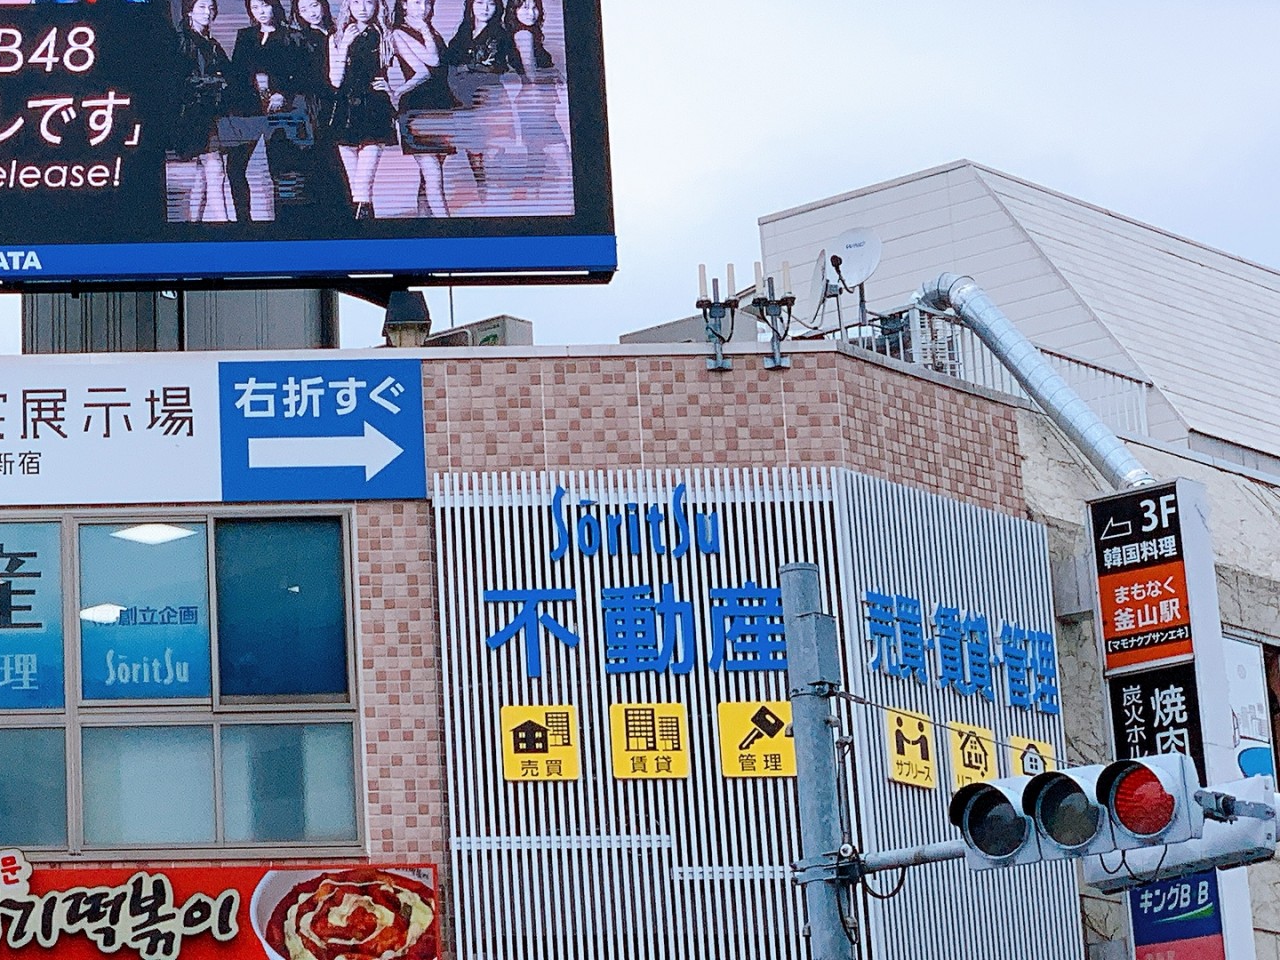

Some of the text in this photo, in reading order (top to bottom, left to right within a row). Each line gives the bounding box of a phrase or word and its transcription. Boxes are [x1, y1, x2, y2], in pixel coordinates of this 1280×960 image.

[234, 376, 404, 419] 右折すぐ
[1139, 494, 1177, 533] 3F
[1103, 535, 1178, 569] 韓国料理
[1114, 576, 1176, 604] まもなく
[483, 581, 787, 678] 不動産
[1114, 597, 1182, 632] 釜山駅
[1150, 684, 1190, 756] 焼肉
[521, 759, 563, 777] 売買
[630, 755, 673, 773] 賃貸
[738, 753, 783, 771] 管理
